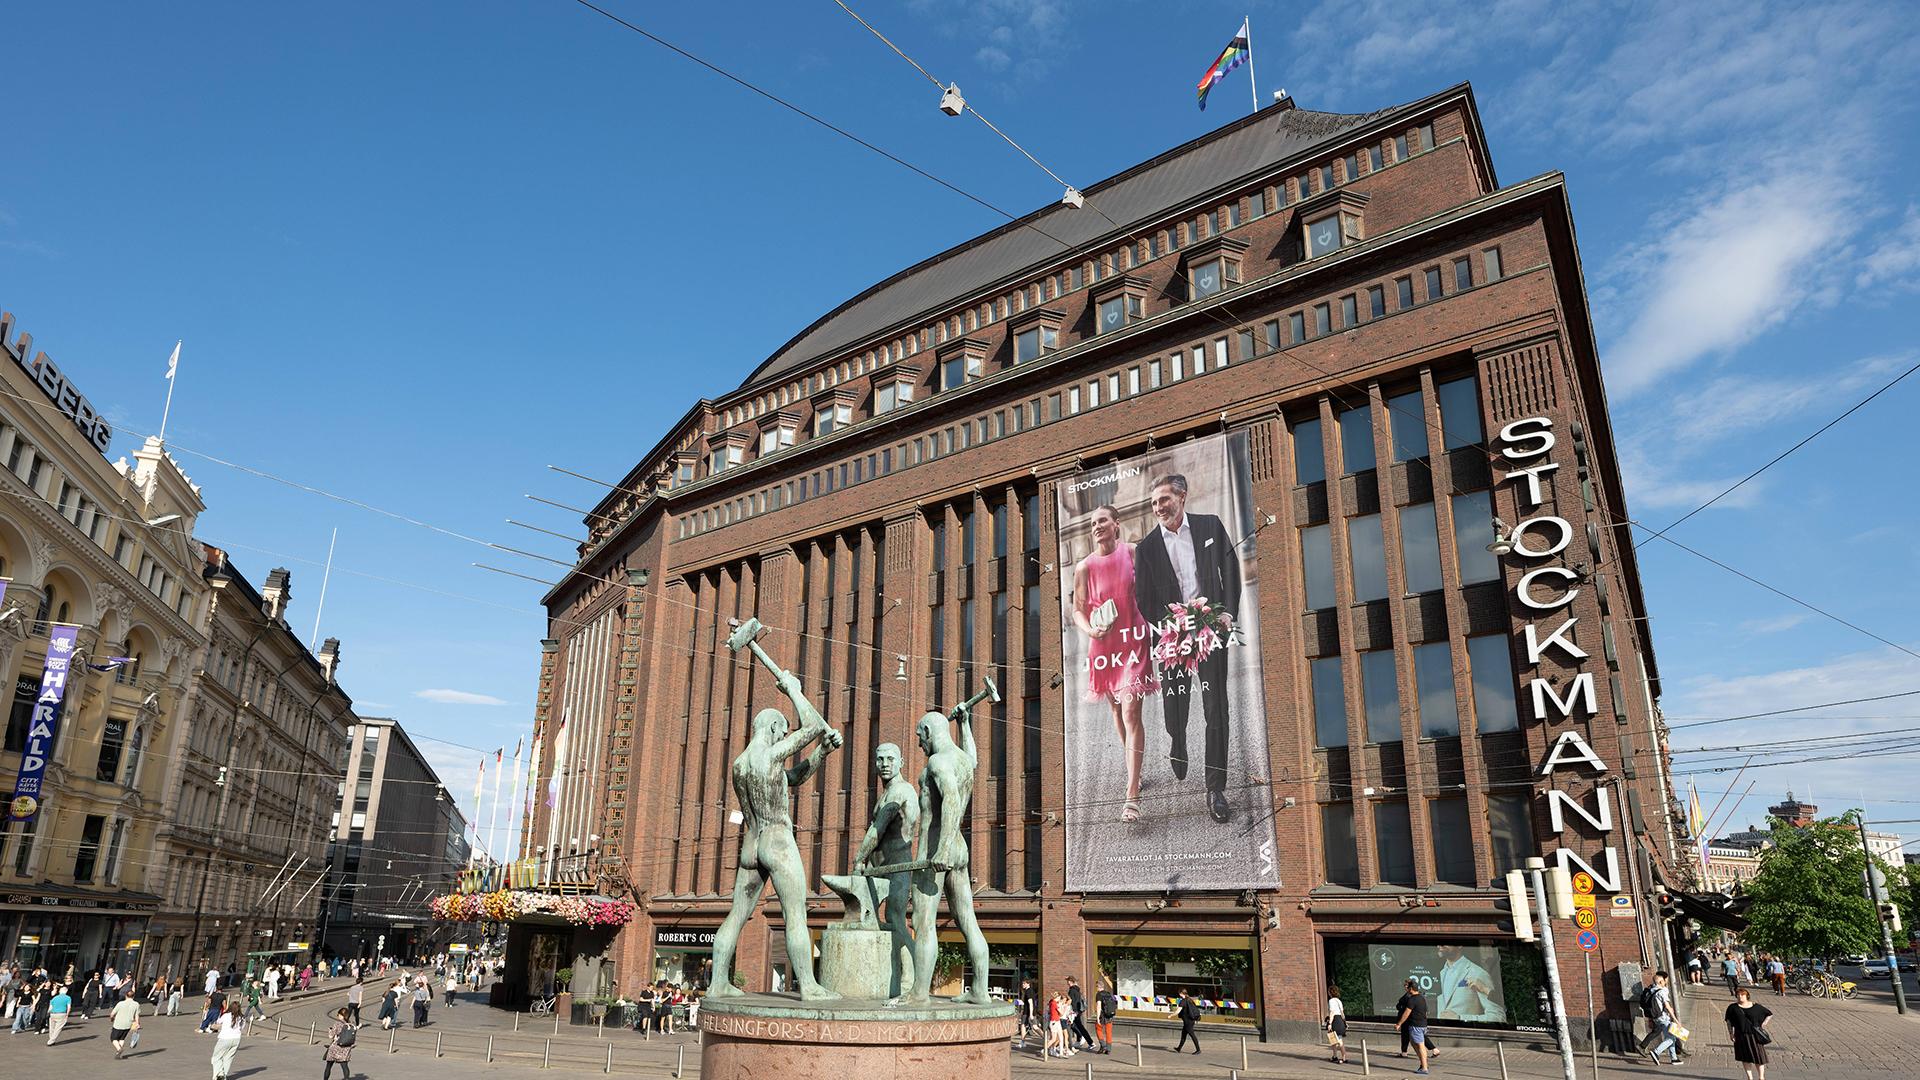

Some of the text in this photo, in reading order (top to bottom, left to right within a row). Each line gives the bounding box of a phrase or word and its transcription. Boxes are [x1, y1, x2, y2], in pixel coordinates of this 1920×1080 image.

[0, 311, 112, 454] LLBERG
[1067, 466, 1140, 494] STOCKMANN
[1119, 614, 1197, 643] TUNNE
[1082, 626, 1241, 673] JOKA KESTÄÄ
[1499, 416, 1622, 893] STOCKMANN
[1126, 668, 1199, 688] KÄNSLAN
[1114, 681, 1210, 705] SOM VARAR
[22, 671, 65, 772] HARALD
[1106, 855, 1153, 863] TAVARATALOT
[1164, 851, 1232, 861] STOCKMANN.COM
[1579, 913, 1593, 924] 20
[658, 933, 716, 943] ROBERT'S COF
[703, 1014, 804, 1039] HELSINGFORS
[820, 1025, 834, 1040] A
[849, 1026, 861, 1040] D
[876, 1023, 970, 1042] MCMXXXII
